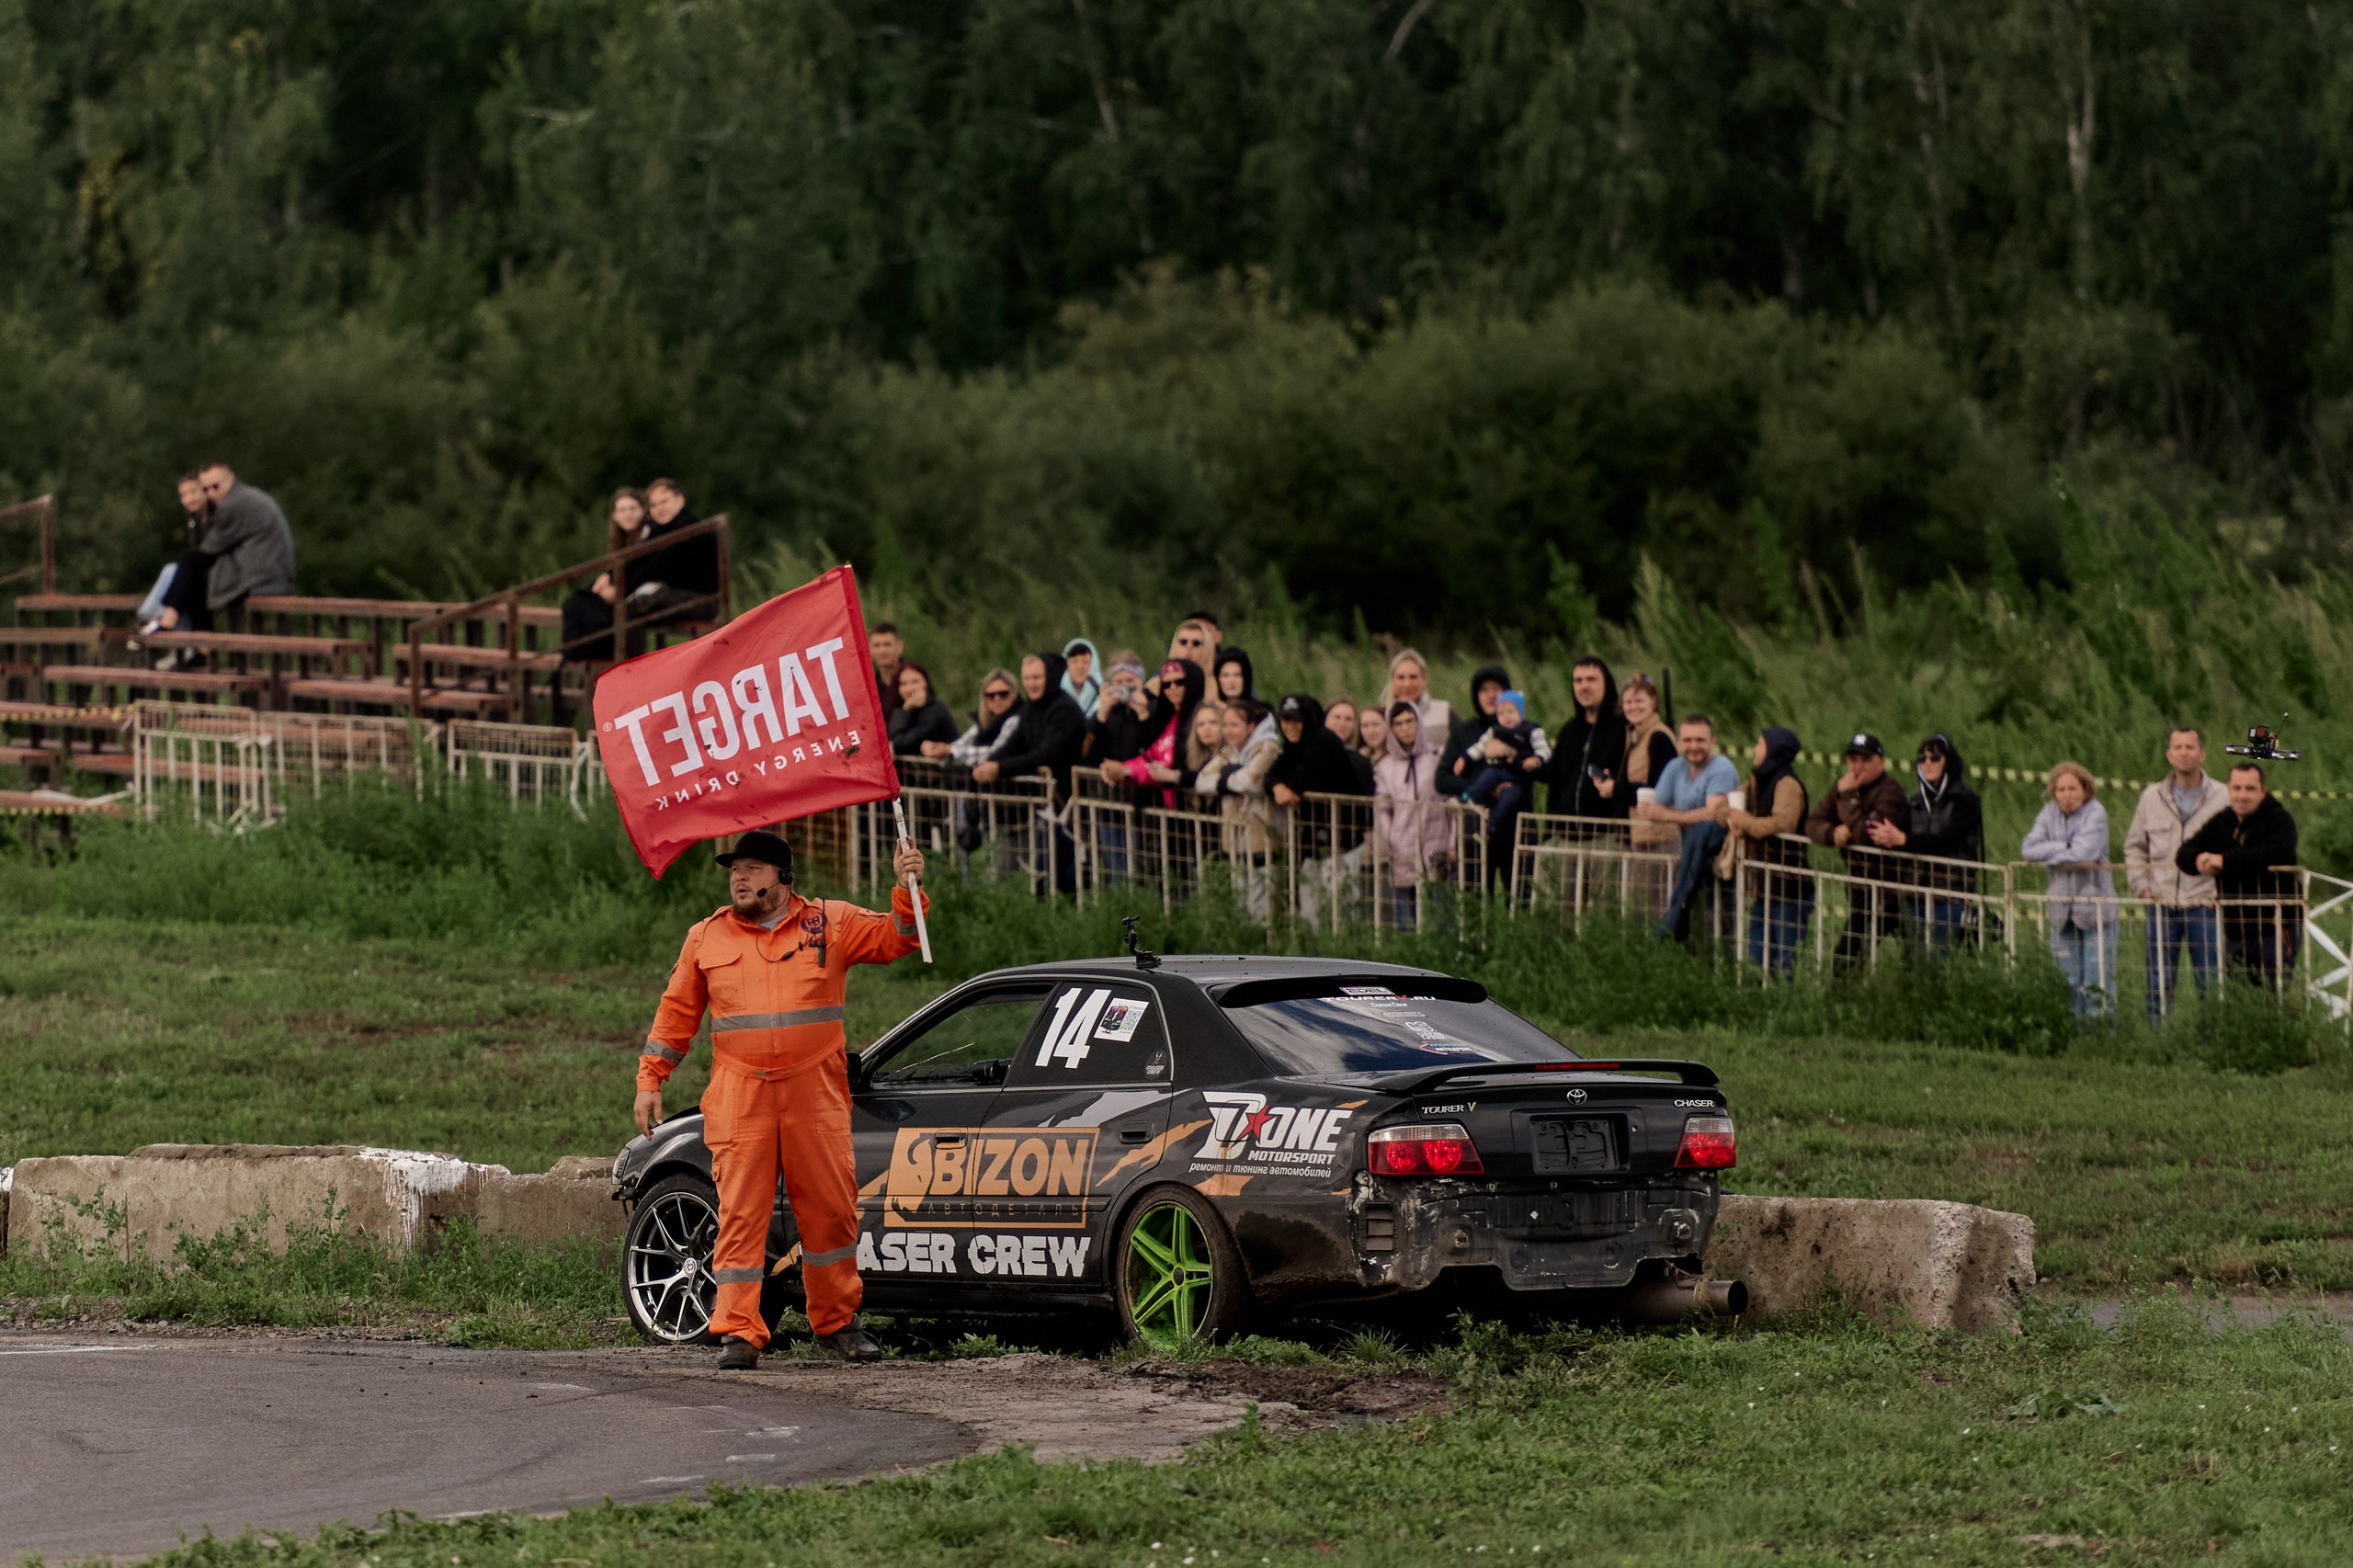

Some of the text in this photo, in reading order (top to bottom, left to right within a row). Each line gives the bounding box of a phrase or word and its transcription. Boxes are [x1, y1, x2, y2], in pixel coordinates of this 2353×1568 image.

[1035, 987, 1112, 1069] 14
[1422, 1102, 1477, 1114] TOURER V
[1674, 1098, 1714, 1108] CHASER
[1247, 1150, 1336, 1165] MOTORSPORT
[929, 1138, 1089, 1196] BIZON
[1188, 1162, 1332, 1177] ремонт и тюнинг автомобилей
[927, 1202, 1079, 1217] АВТОДЕТАЛЬ
[857, 1231, 1091, 1278] ASER CREW
